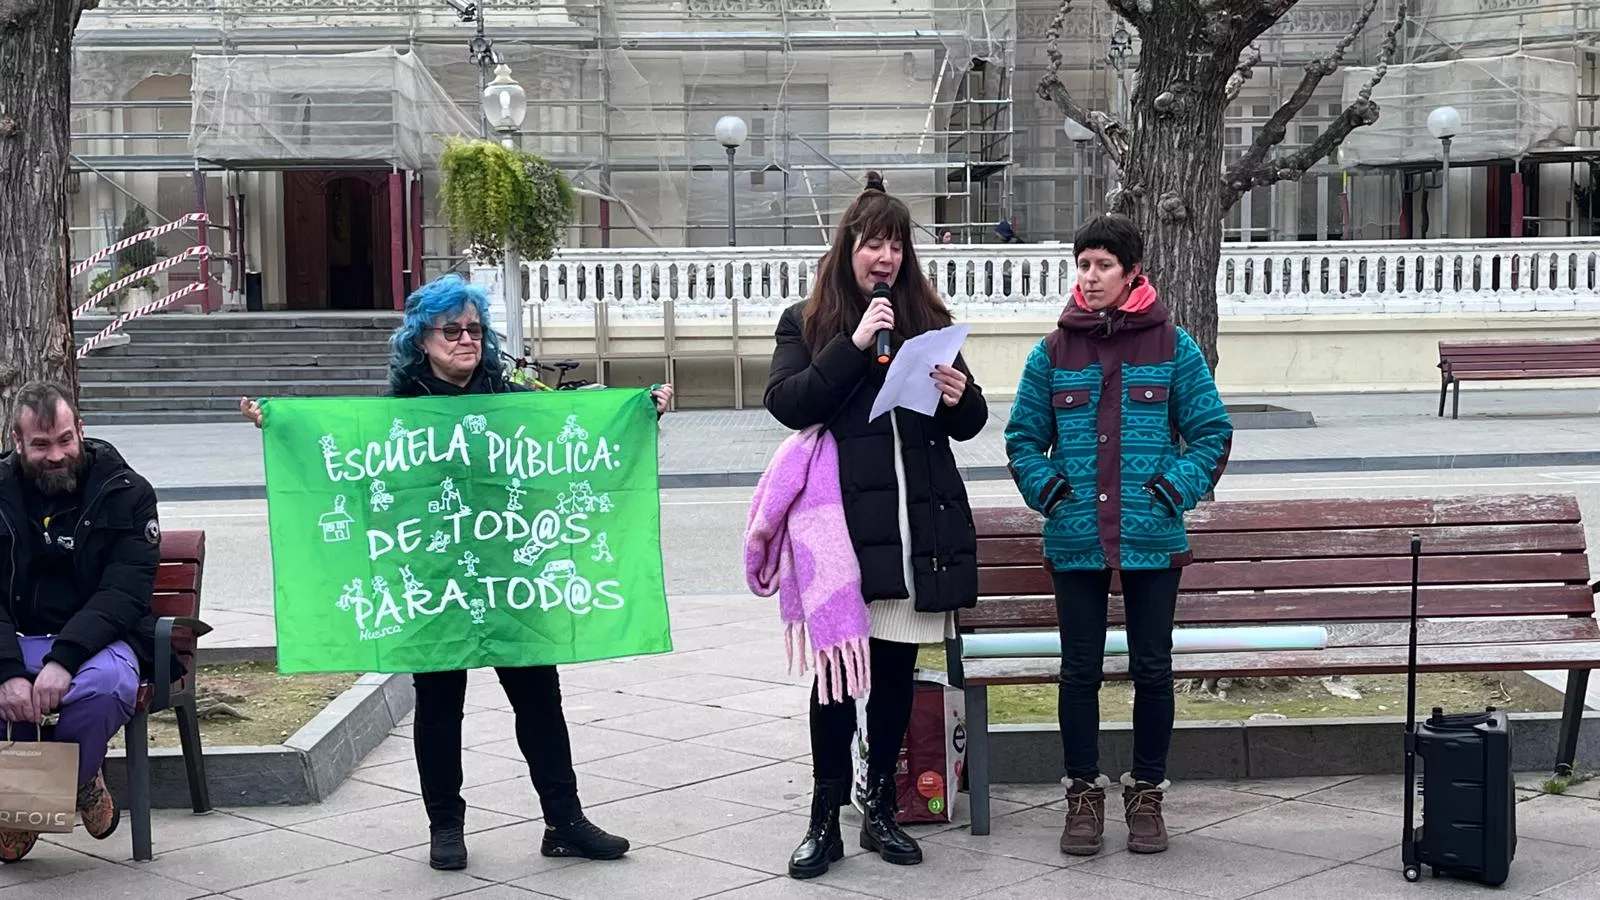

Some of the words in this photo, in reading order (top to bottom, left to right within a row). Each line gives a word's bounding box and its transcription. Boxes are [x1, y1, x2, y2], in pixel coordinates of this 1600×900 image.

[325, 423, 471, 482] ESCUELA
[485, 425, 620, 479] PÚBLICA:
[366, 518, 422, 560] DE
[443, 509, 591, 549] TOD@S
[354, 578, 470, 629] PARA
[478, 576, 624, 614] TOD@S
[359, 624, 403, 641] Huesca
